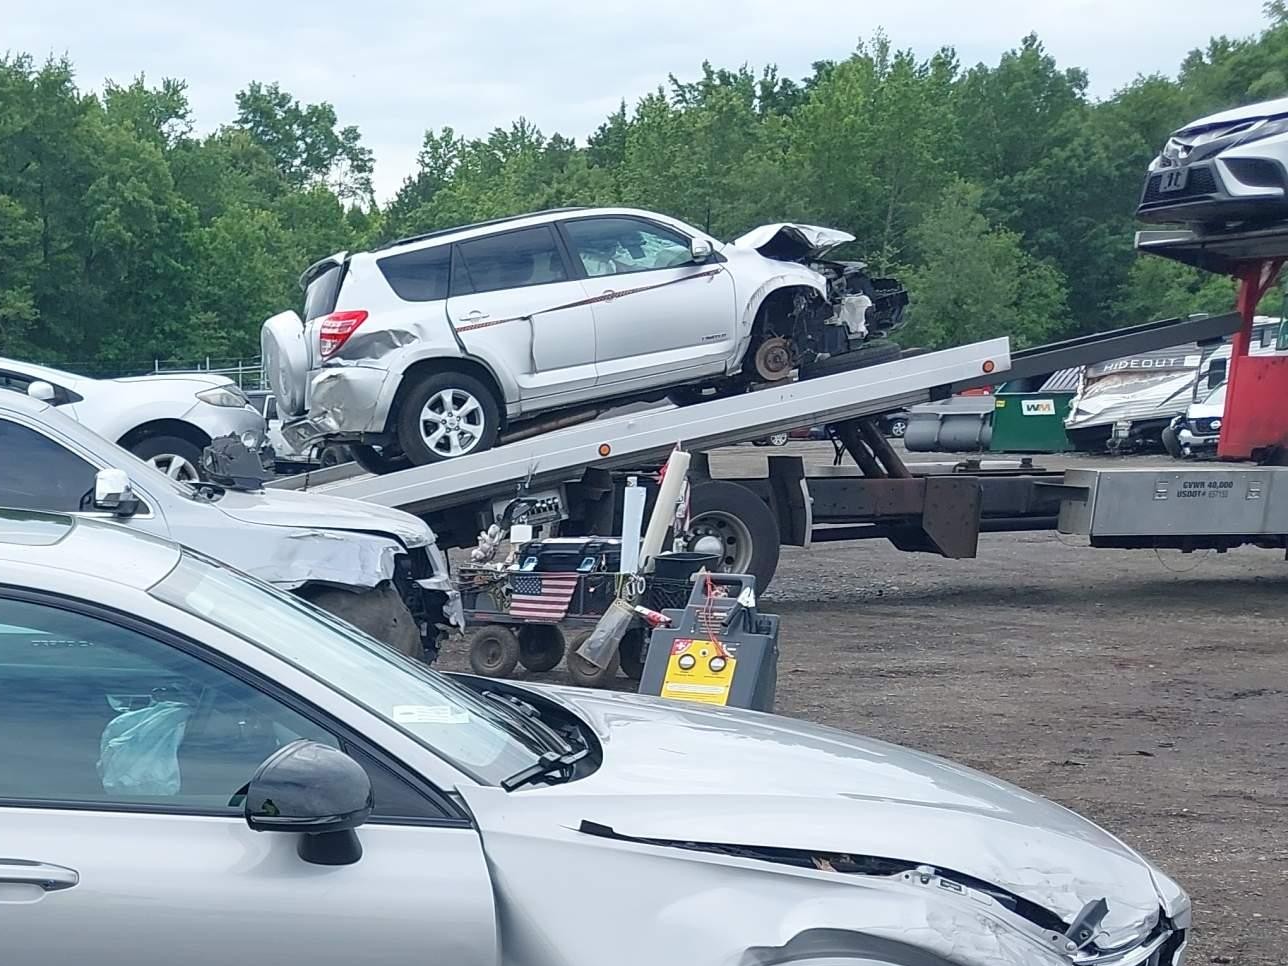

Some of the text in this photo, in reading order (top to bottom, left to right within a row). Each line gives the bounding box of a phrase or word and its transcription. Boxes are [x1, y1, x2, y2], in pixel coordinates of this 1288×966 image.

[1103, 358, 1178, 372] HIDEOUT
[1026, 403, 1051, 412] WM
[1183, 481, 1234, 490] GVWR 40,000
